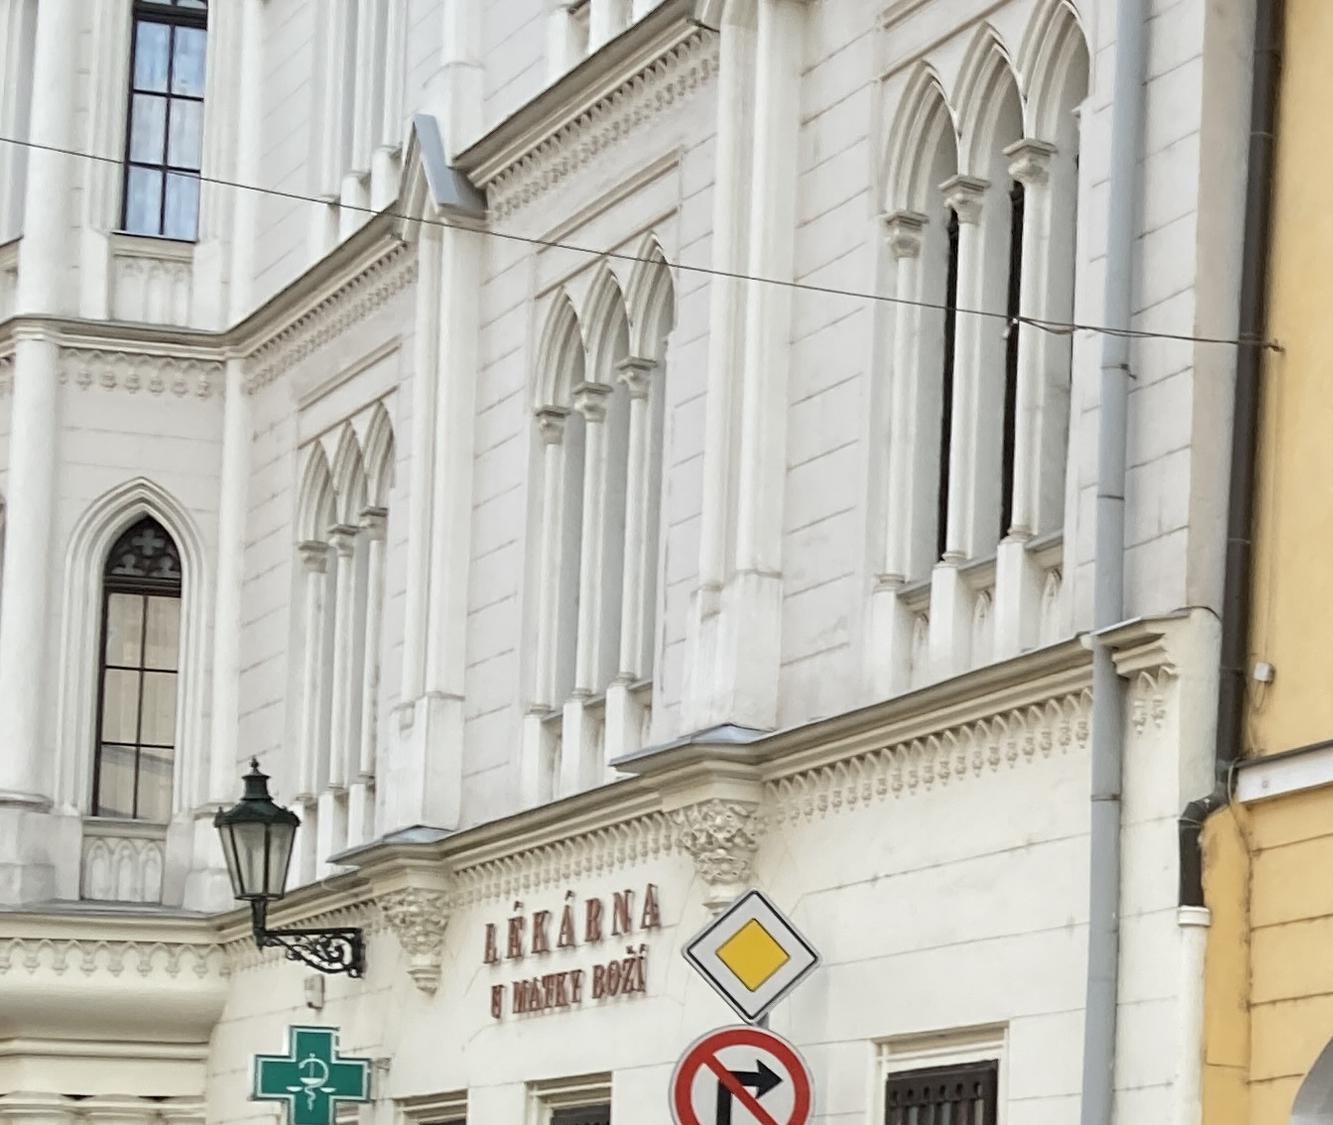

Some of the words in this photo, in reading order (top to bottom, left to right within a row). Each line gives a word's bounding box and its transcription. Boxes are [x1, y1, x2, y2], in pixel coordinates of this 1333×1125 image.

[483, 883, 662, 964] LÉKÁRNA
[512, 969, 583, 1014] MATKY
[592, 943, 649, 999] BOŽÍ
